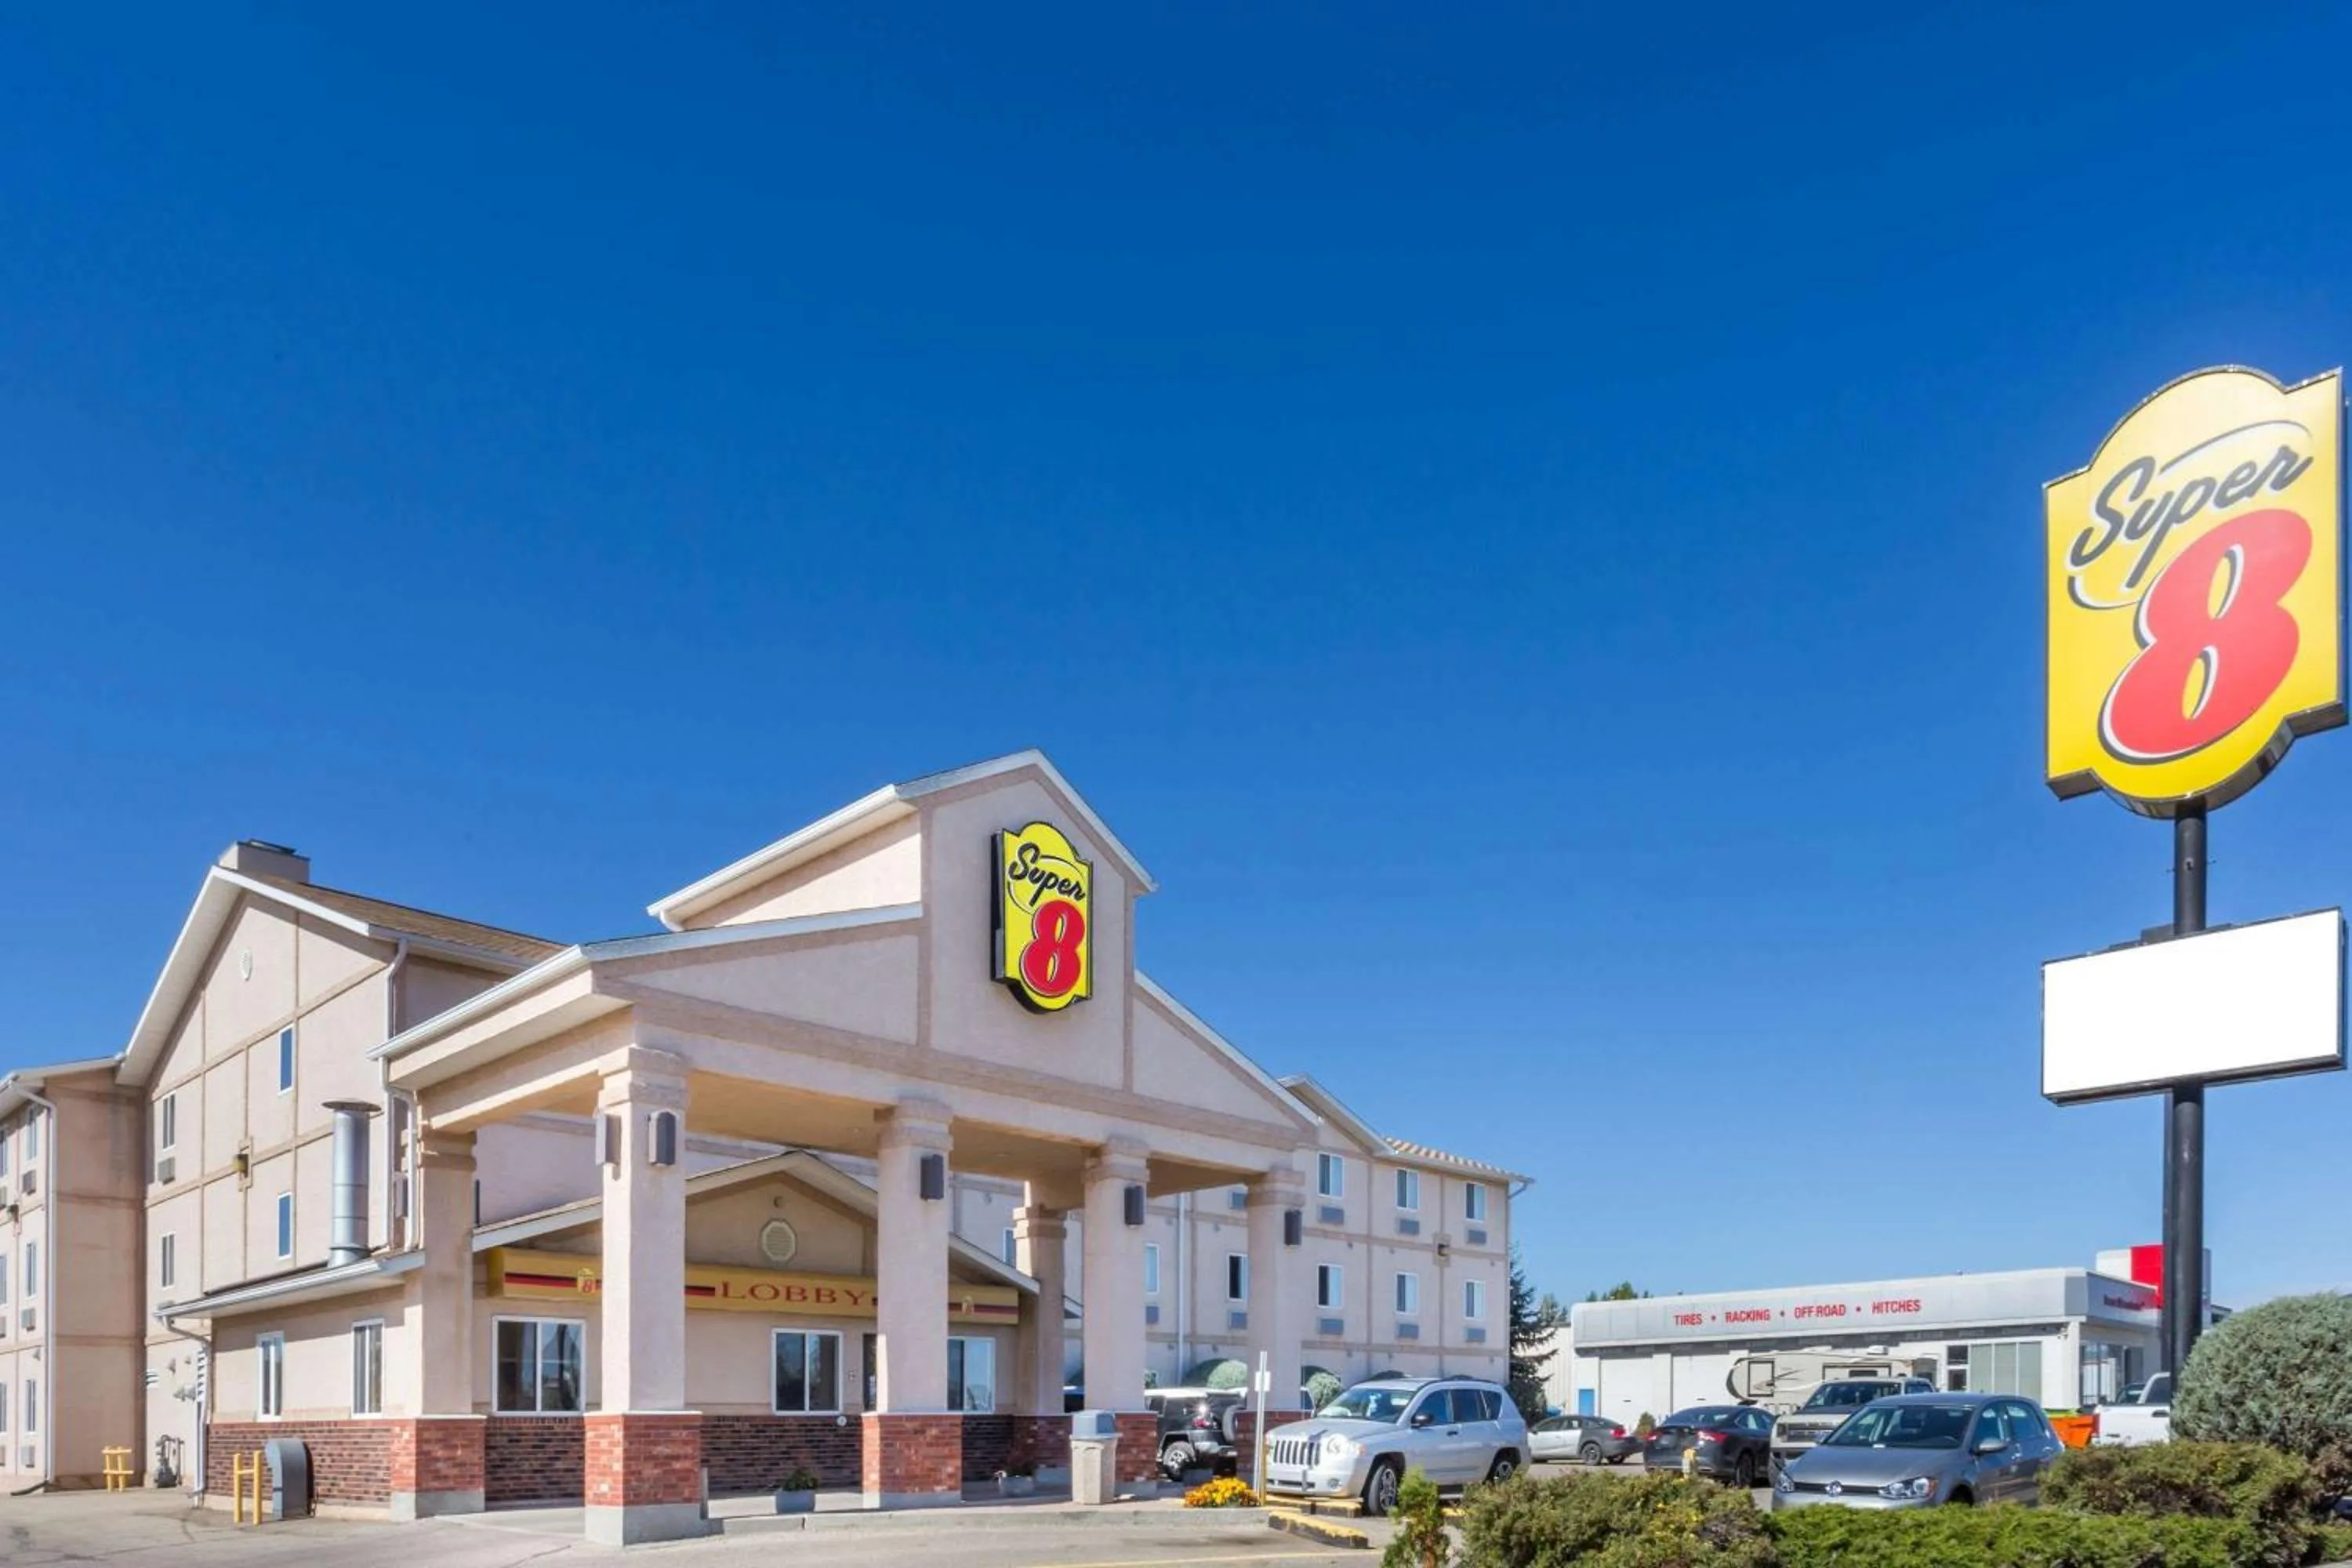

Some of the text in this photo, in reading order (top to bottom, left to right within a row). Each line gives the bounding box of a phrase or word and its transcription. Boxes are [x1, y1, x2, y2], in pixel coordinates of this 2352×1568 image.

[2068, 444, 2314, 590] Super
[2097, 509, 2313, 765] 8
[1008, 842, 1086, 907] Super
[1020, 899, 1086, 998] 8
[721, 1279, 867, 1306] LOBBY
[1673, 1312, 1703, 1327] TIRES
[1725, 1308, 1771, 1323] RACKING
[1871, 1298, 1921, 1315] HITCHES
